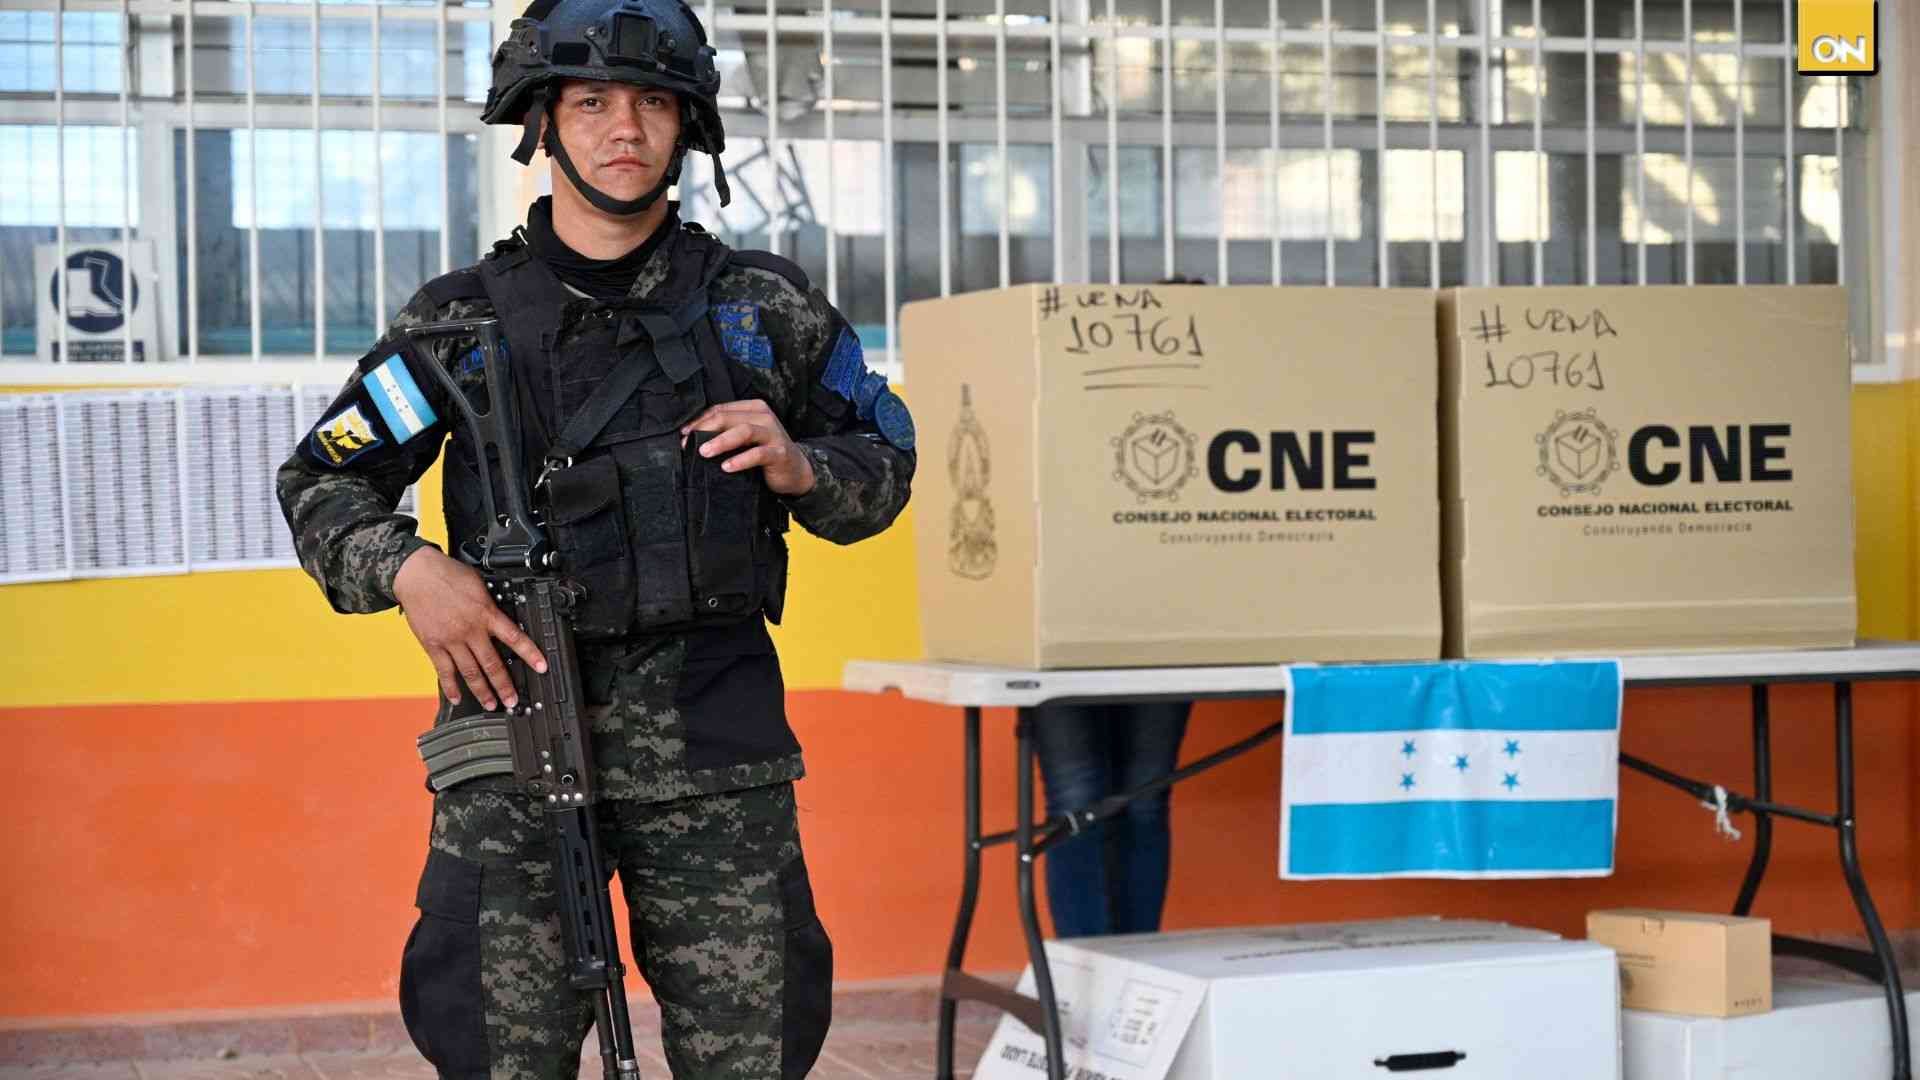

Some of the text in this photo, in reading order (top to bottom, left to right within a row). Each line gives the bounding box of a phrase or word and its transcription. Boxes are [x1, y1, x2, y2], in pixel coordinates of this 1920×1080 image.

[1065, 313, 1205, 357] 10761
[1485, 351, 1605, 391] 10761
[1207, 429, 1377, 494] CNE
[1628, 423, 1793, 487] CNE
[1112, 508, 1377, 524] CONSEJO NACIONAL ELECTORAL
[1537, 499, 1794, 517] CONSEJO NACIONAL ELECTORAL
[1583, 520, 1753, 537] Construyendo Democracia
